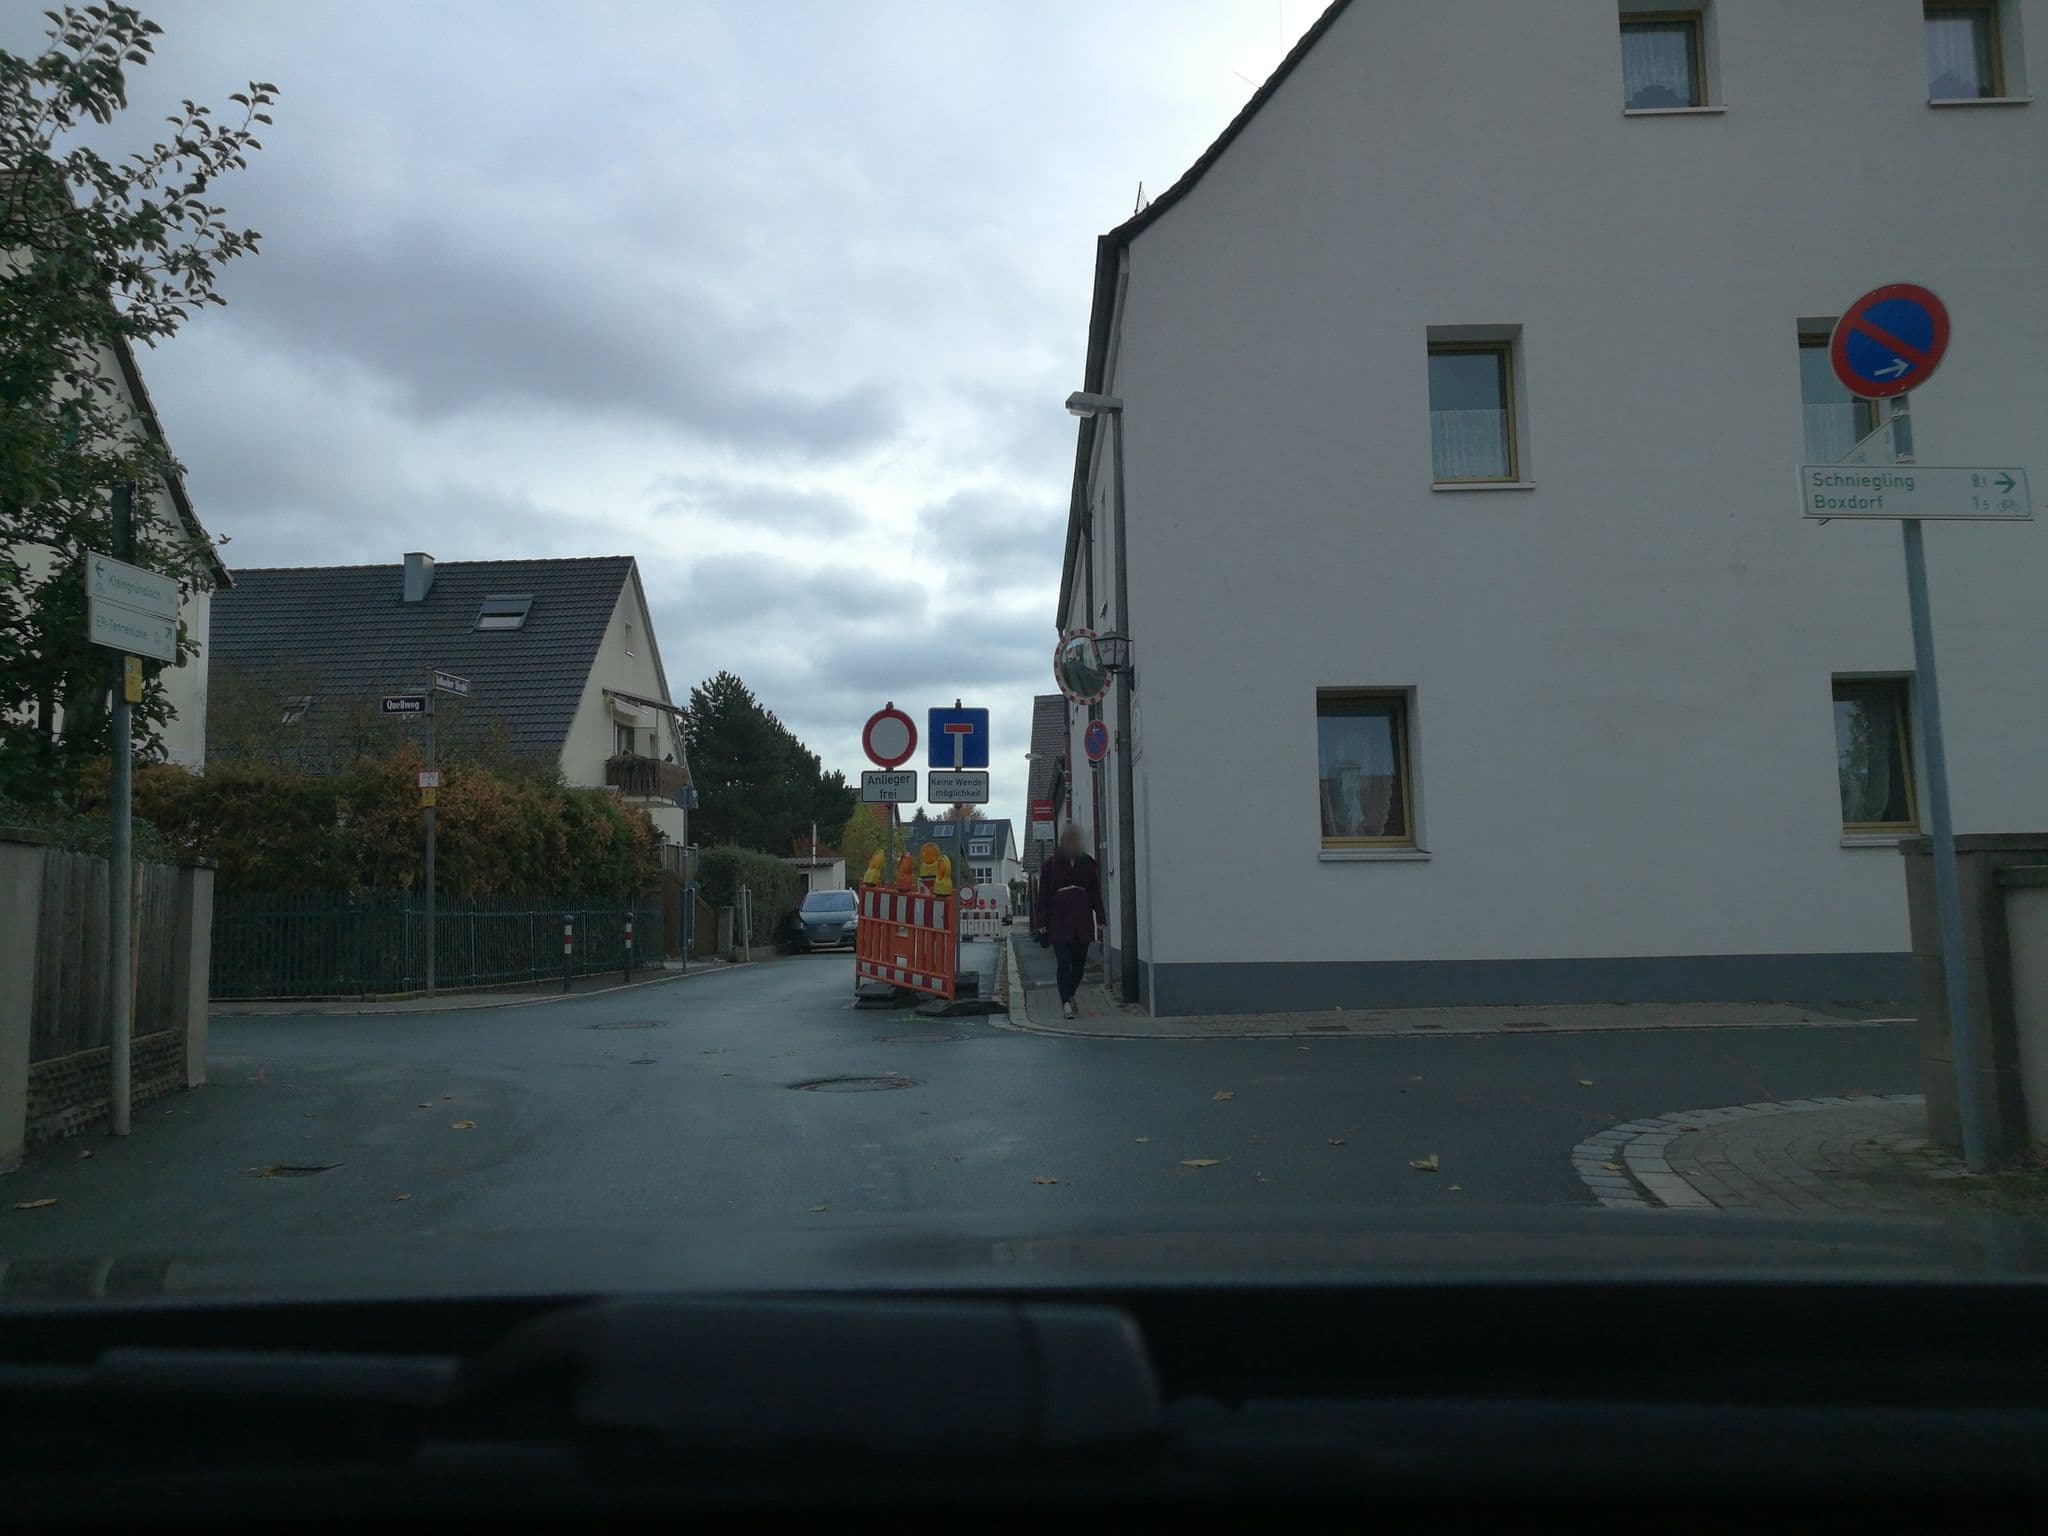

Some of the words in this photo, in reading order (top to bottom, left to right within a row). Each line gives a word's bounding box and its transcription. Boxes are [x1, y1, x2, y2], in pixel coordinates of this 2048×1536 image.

[1812, 472, 1915, 491] Schniegling
[1814, 494, 1884, 510] Boxdorf
[386, 700, 420, 710] Quellweg
[867, 775, 911, 786] Anlieger
[880, 788, 897, 800] frei
[935, 789, 981, 798] möglichkeit
